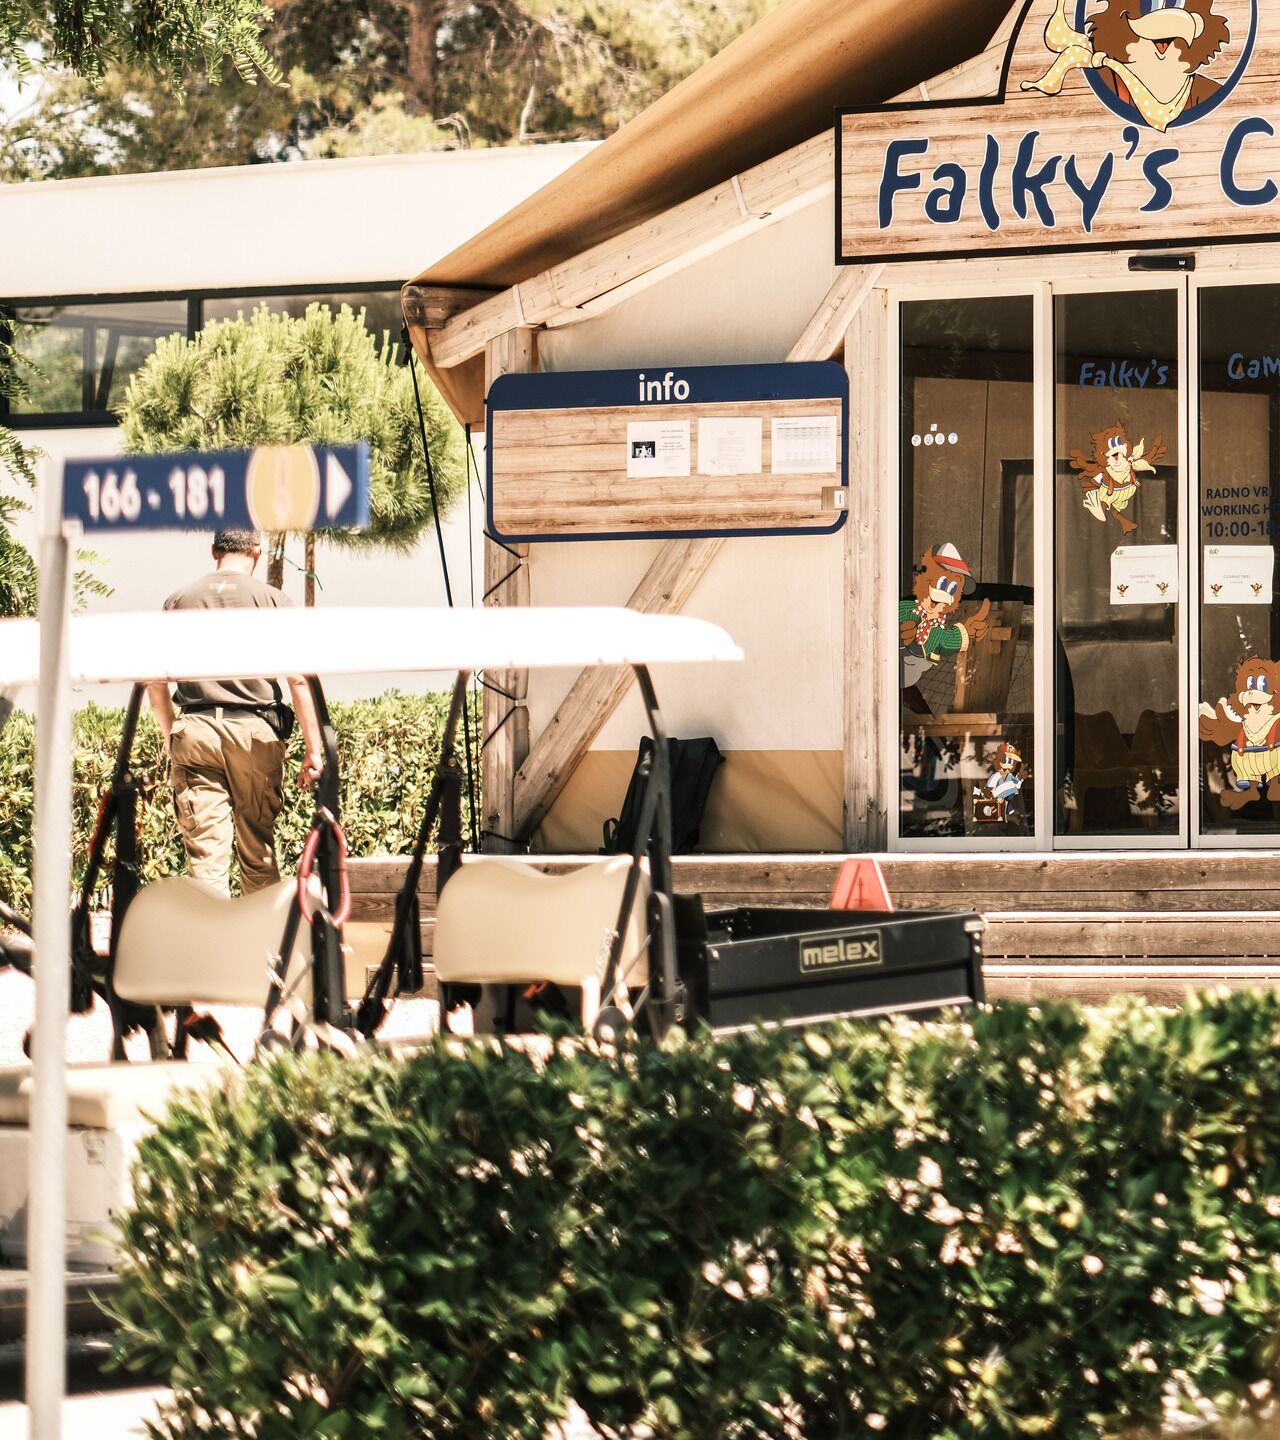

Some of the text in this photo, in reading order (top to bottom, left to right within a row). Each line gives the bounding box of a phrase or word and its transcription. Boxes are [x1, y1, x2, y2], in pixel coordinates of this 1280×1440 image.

[878, 126, 1180, 234] Falky's
[639, 371, 690, 402] info
[1079, 359, 1169, 389] Falky's
[83, 468, 142, 523] 166
[168, 464, 226, 520] 181
[1206, 487, 1250, 500] RADNO
[1202, 504, 1260, 517] WORKING
[803, 939, 879, 966] melex
